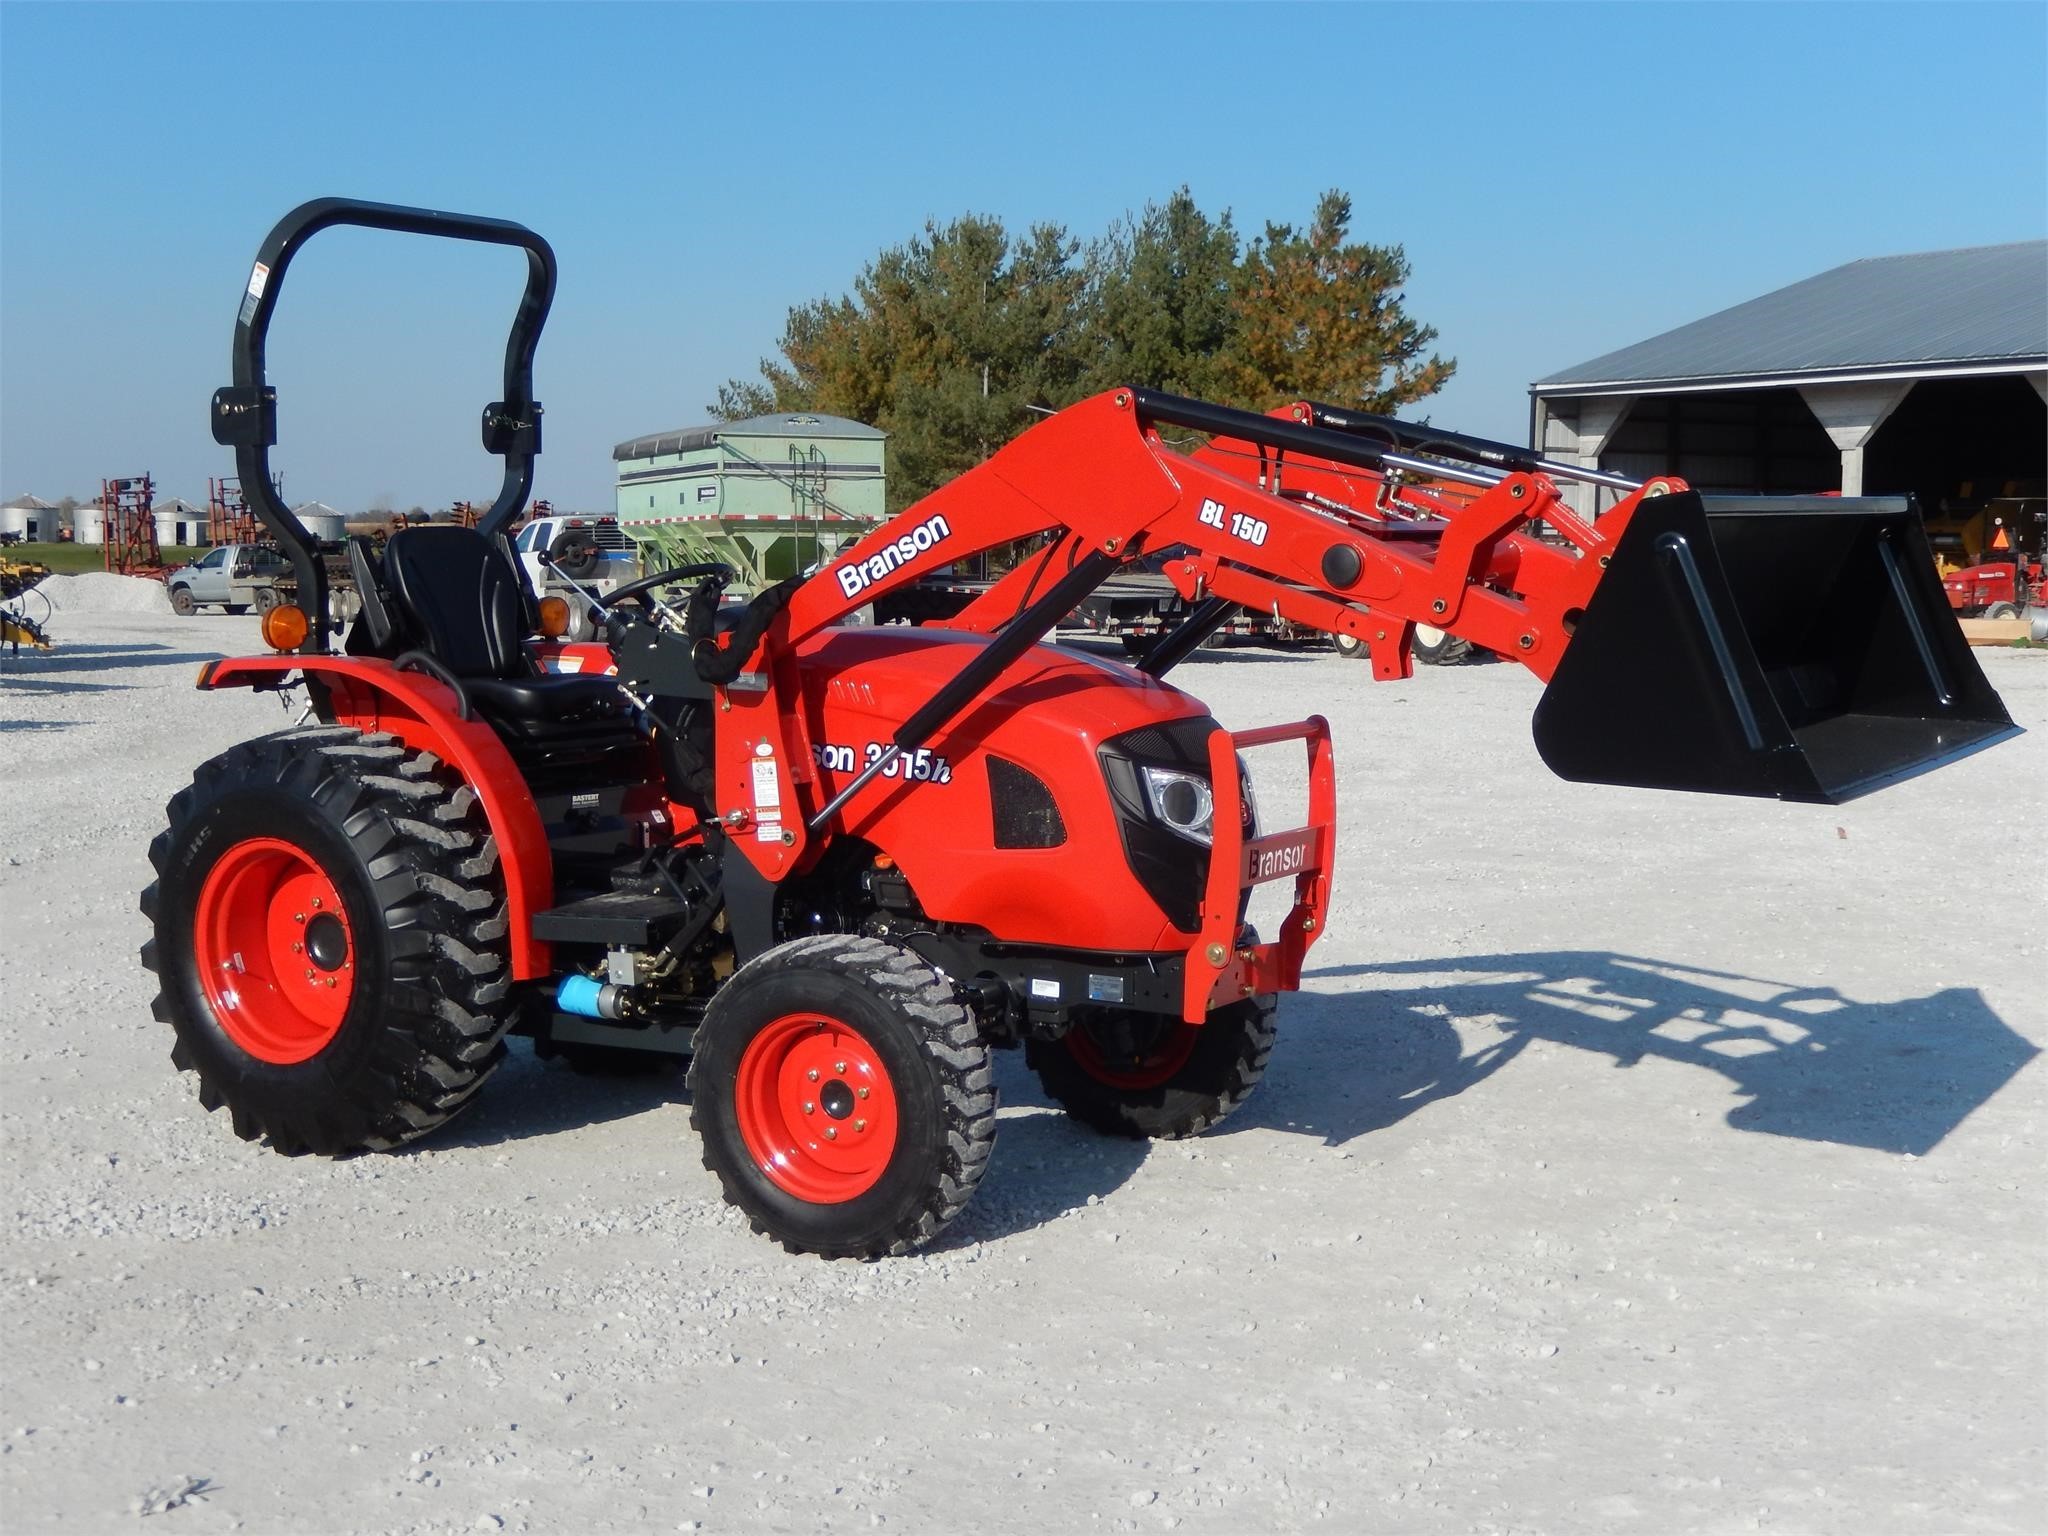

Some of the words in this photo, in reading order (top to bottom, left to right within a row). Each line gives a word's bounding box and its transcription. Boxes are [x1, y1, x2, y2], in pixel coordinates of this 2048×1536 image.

[1199, 498, 1225, 530] BL
[1231, 512, 1268, 546] 150
[836, 514, 951, 599] Branson
